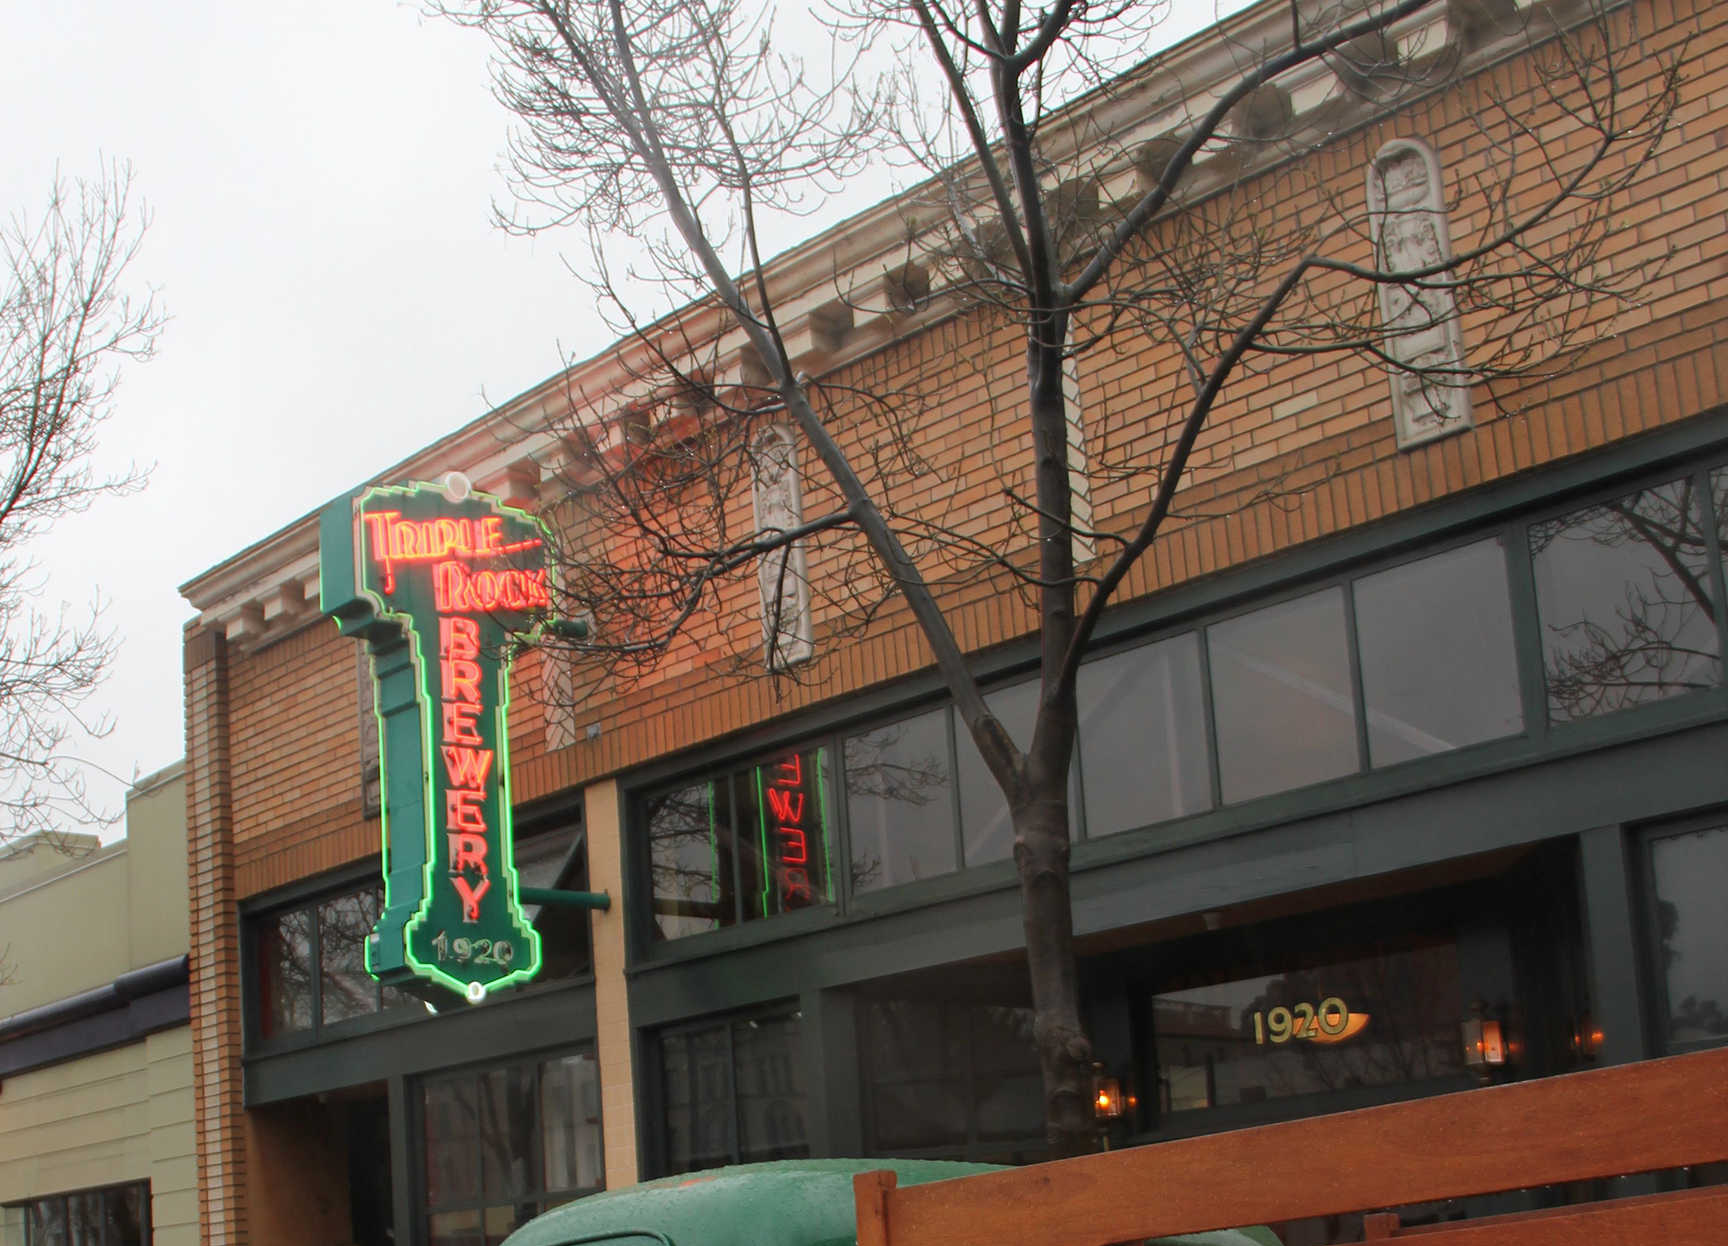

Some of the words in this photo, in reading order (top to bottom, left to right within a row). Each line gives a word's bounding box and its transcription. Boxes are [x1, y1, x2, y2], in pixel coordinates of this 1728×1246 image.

[364, 511, 520, 585] TRIPLE
[434, 561, 547, 612] ROCK
[438, 616, 492, 923] BREWERY
[430, 930, 513, 964] 1920
[1253, 996, 1350, 1045] 1920
